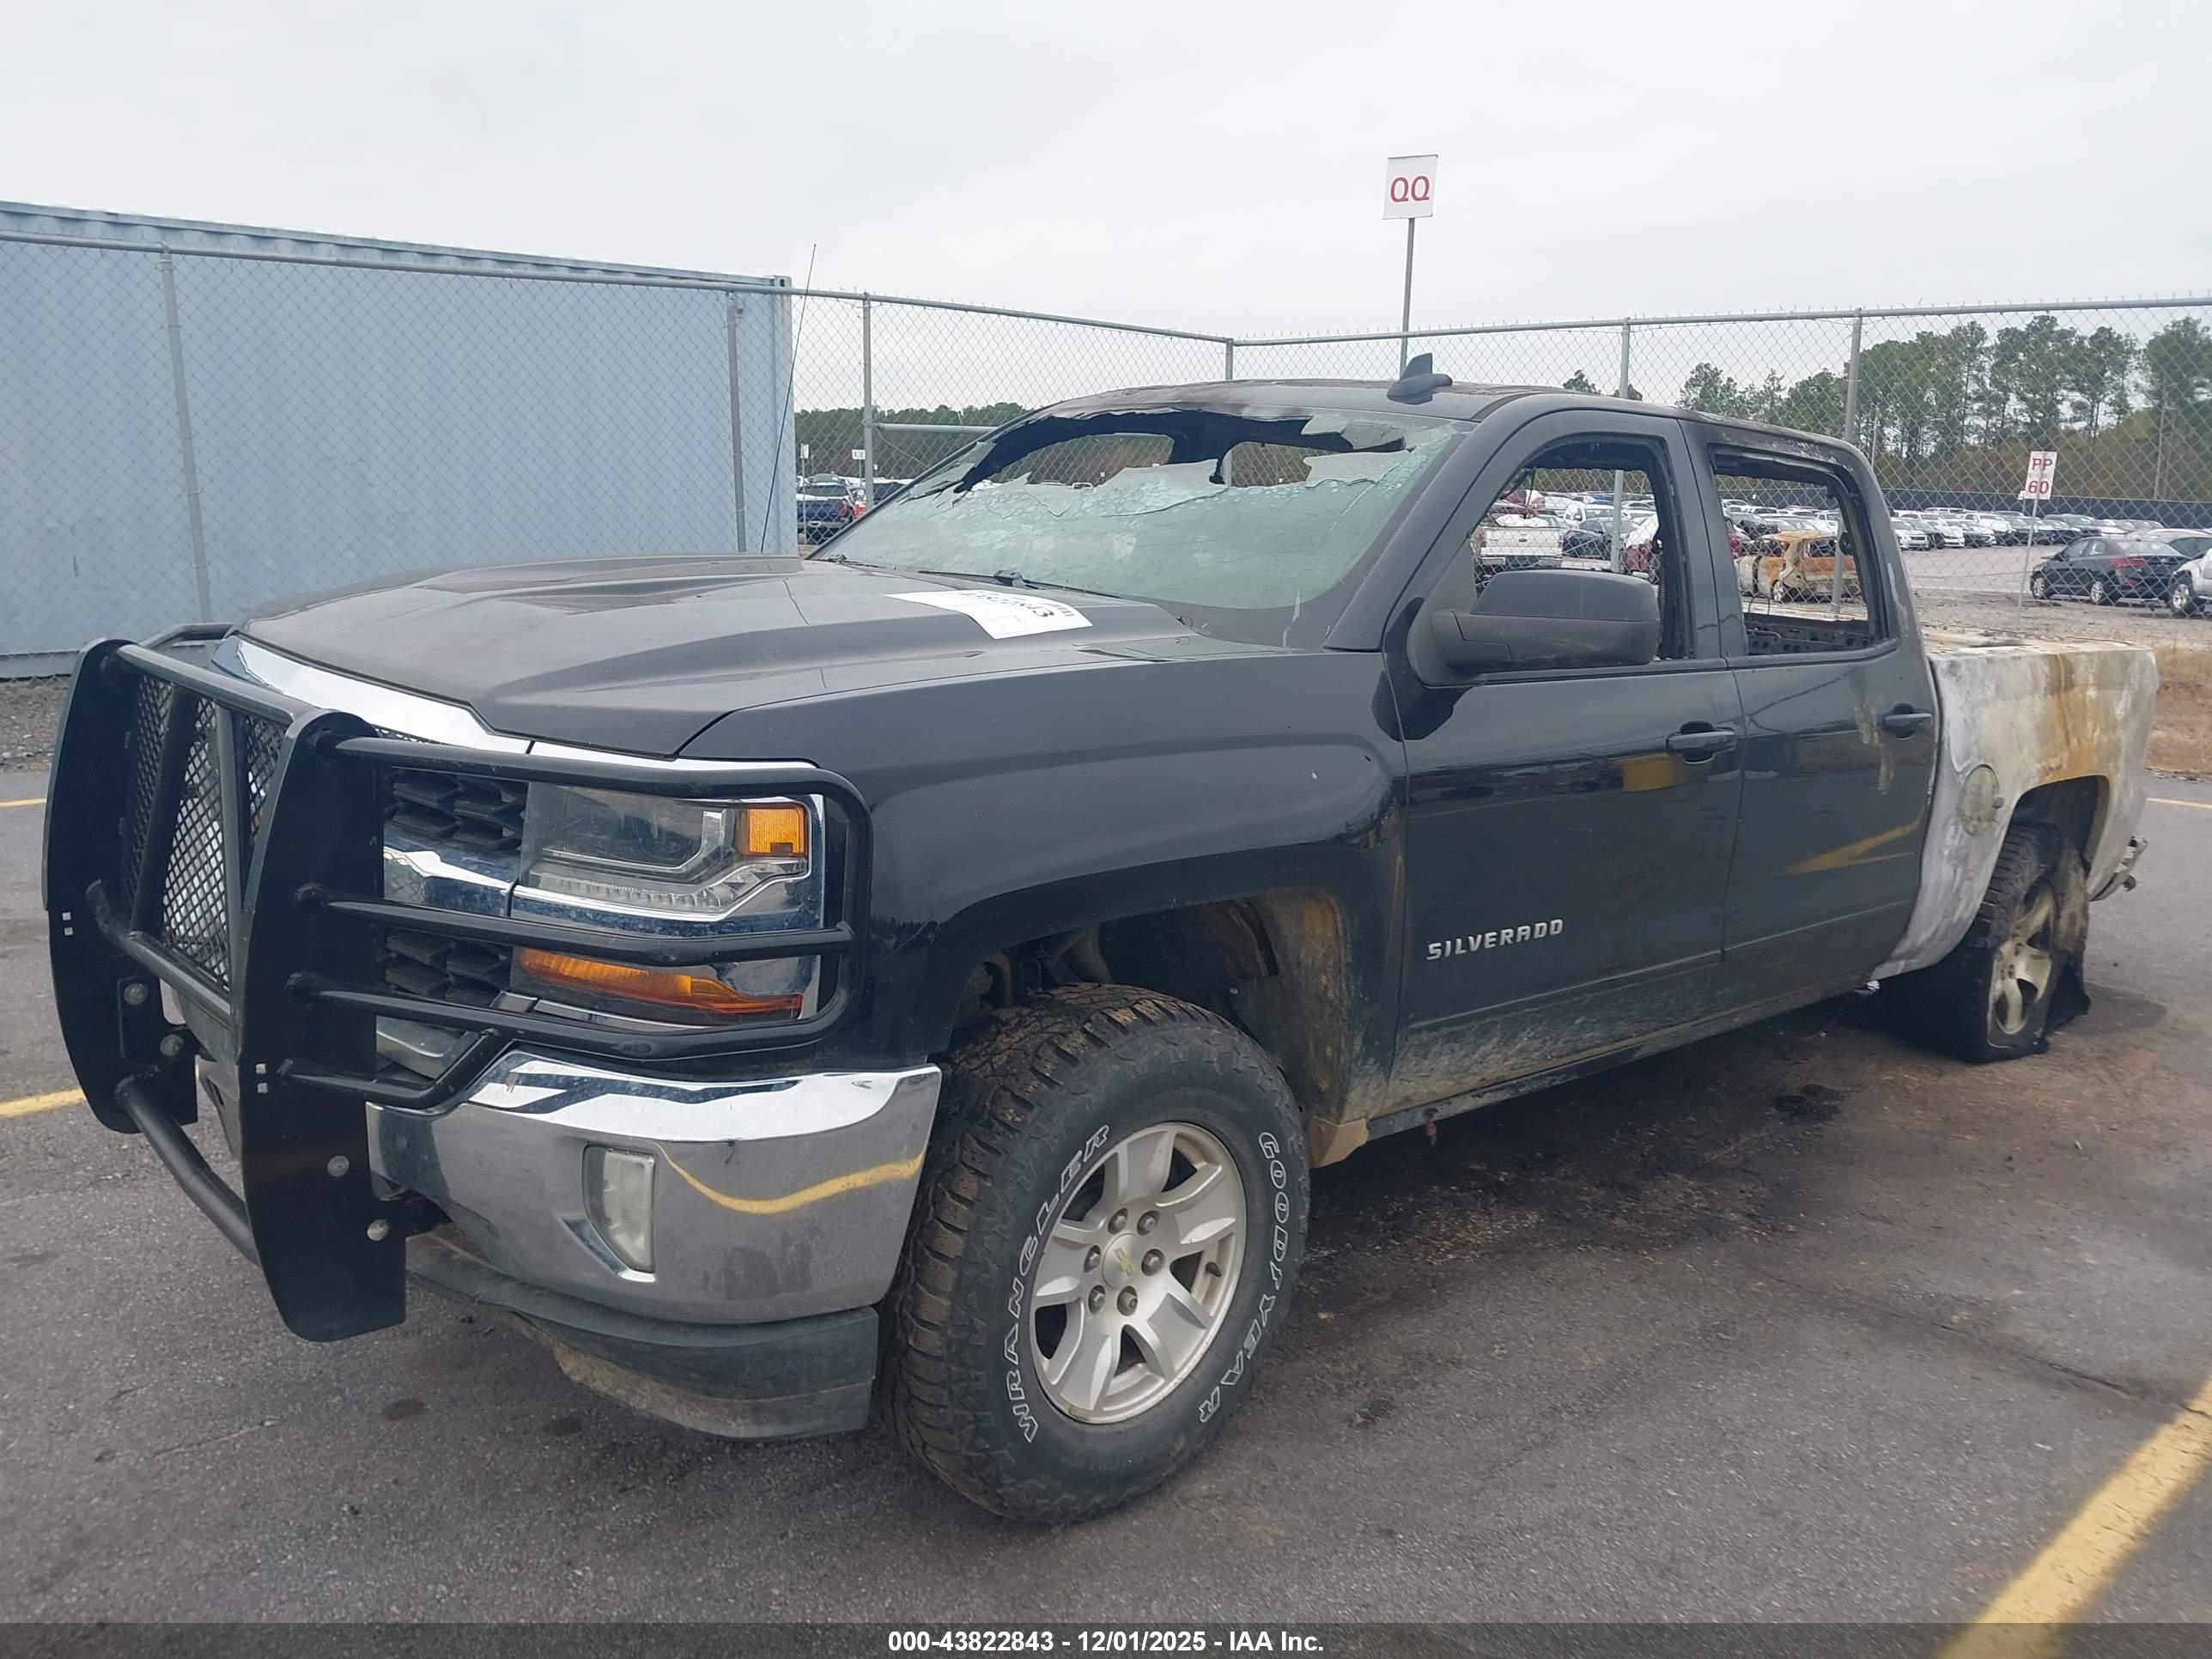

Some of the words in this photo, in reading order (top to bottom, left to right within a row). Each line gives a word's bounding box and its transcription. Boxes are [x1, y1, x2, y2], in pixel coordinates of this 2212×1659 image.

[1390, 175, 1430, 203] QQ
[2032, 458, 2053, 471] PP
[2027, 480, 2050, 495] 60
[1425, 919, 1564, 961] SILVERADO
[1004, 1125, 1109, 1443] WRANGLER
[1199, 1132, 1289, 1423] GOODYEAR
